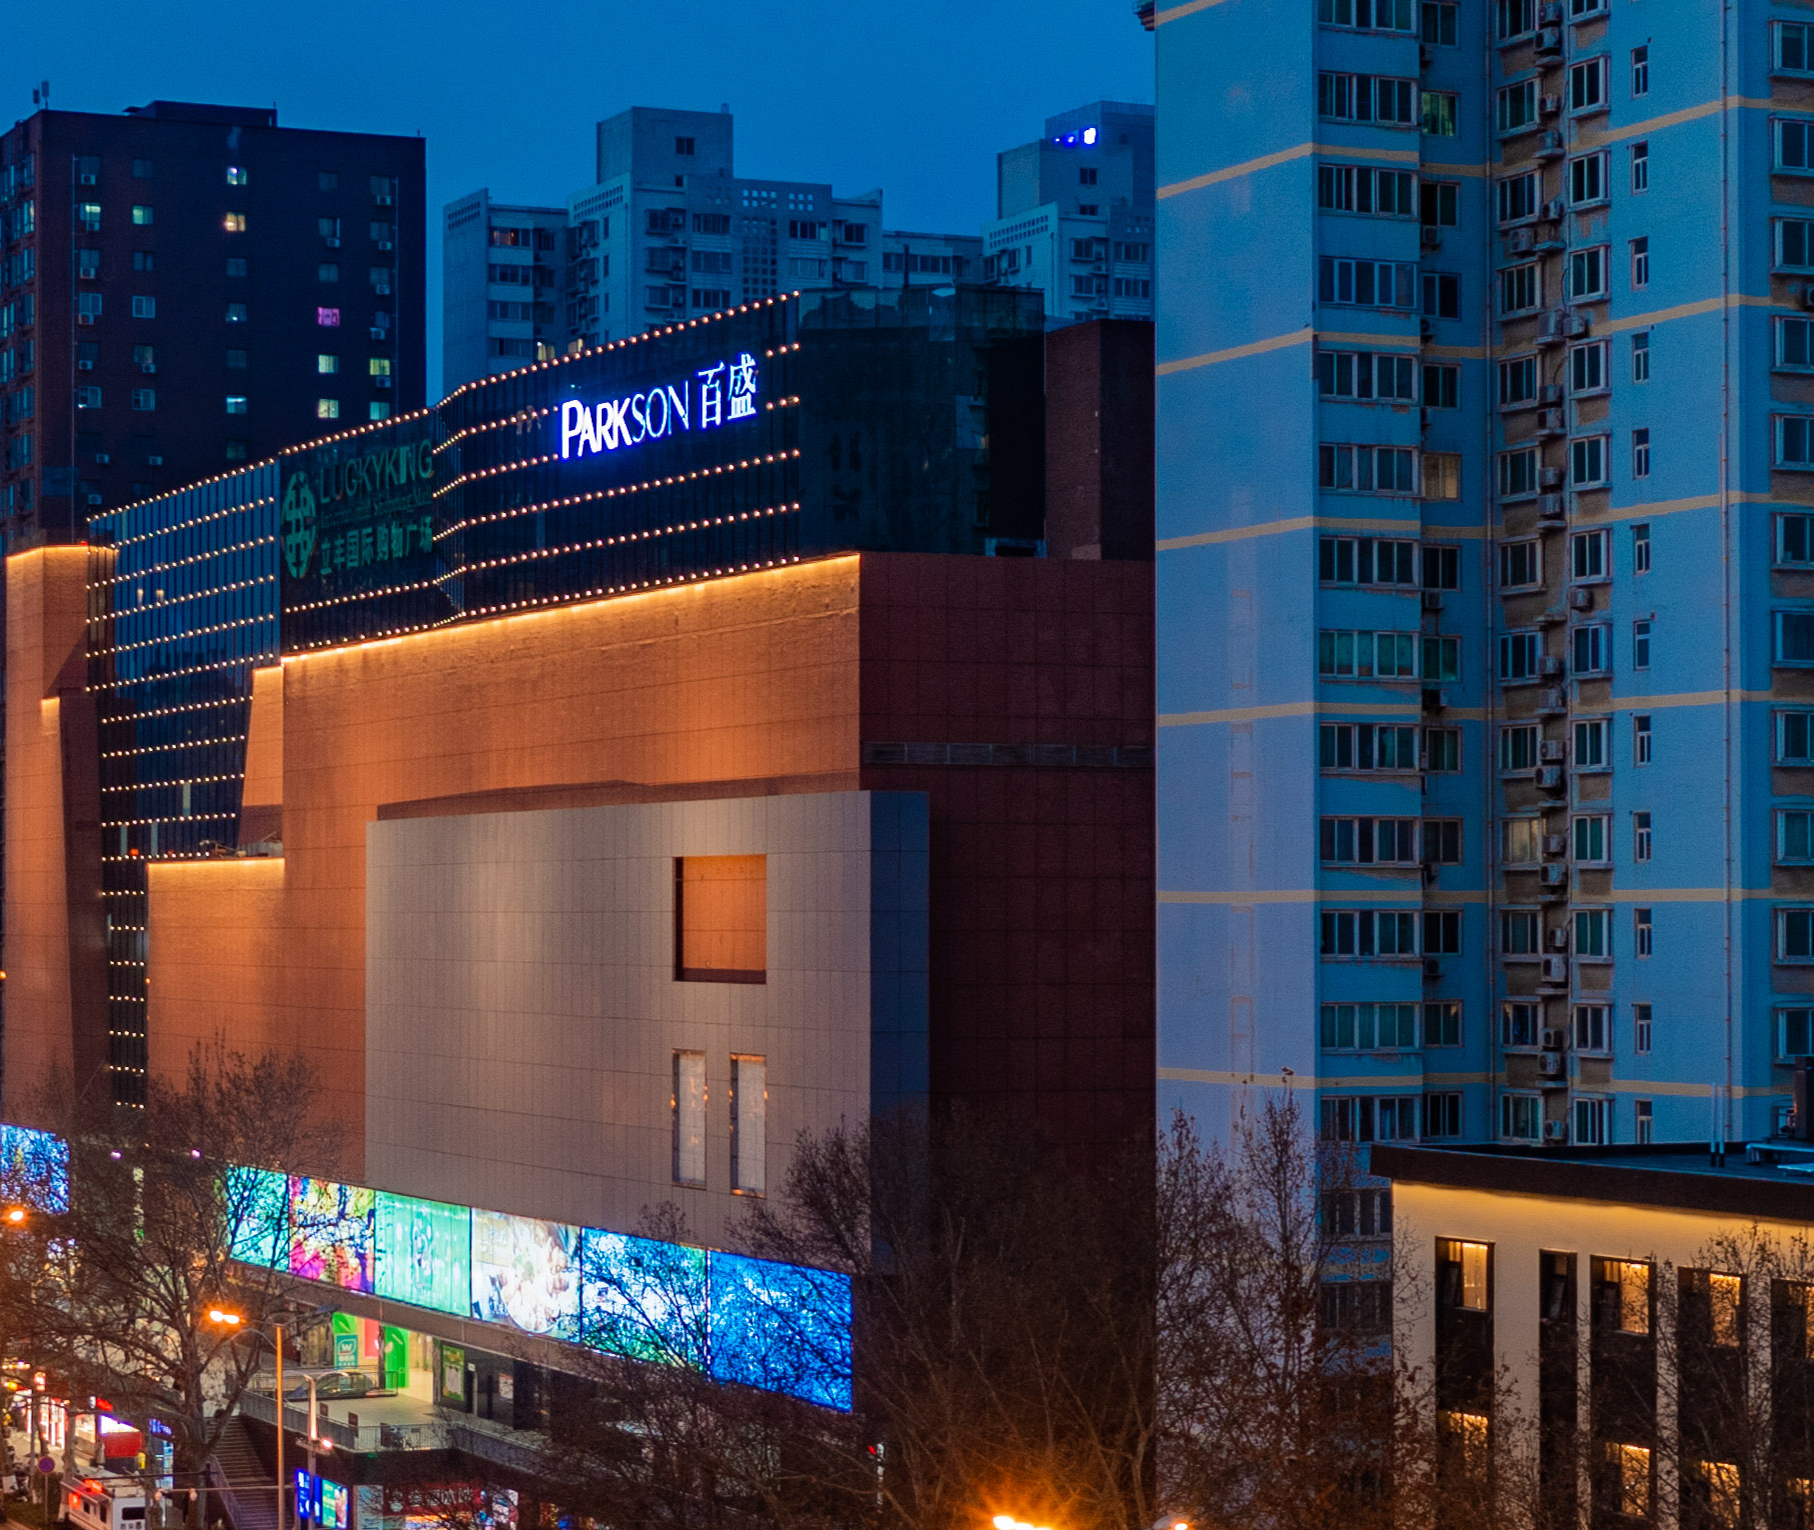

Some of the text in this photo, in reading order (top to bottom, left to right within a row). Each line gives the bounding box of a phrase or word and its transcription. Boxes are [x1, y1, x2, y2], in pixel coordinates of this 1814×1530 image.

[561, 379, 689, 459] PARKSON
[697, 353, 757, 429] 百盛
[320, 516, 432, 574] 立丰国际购物广场
